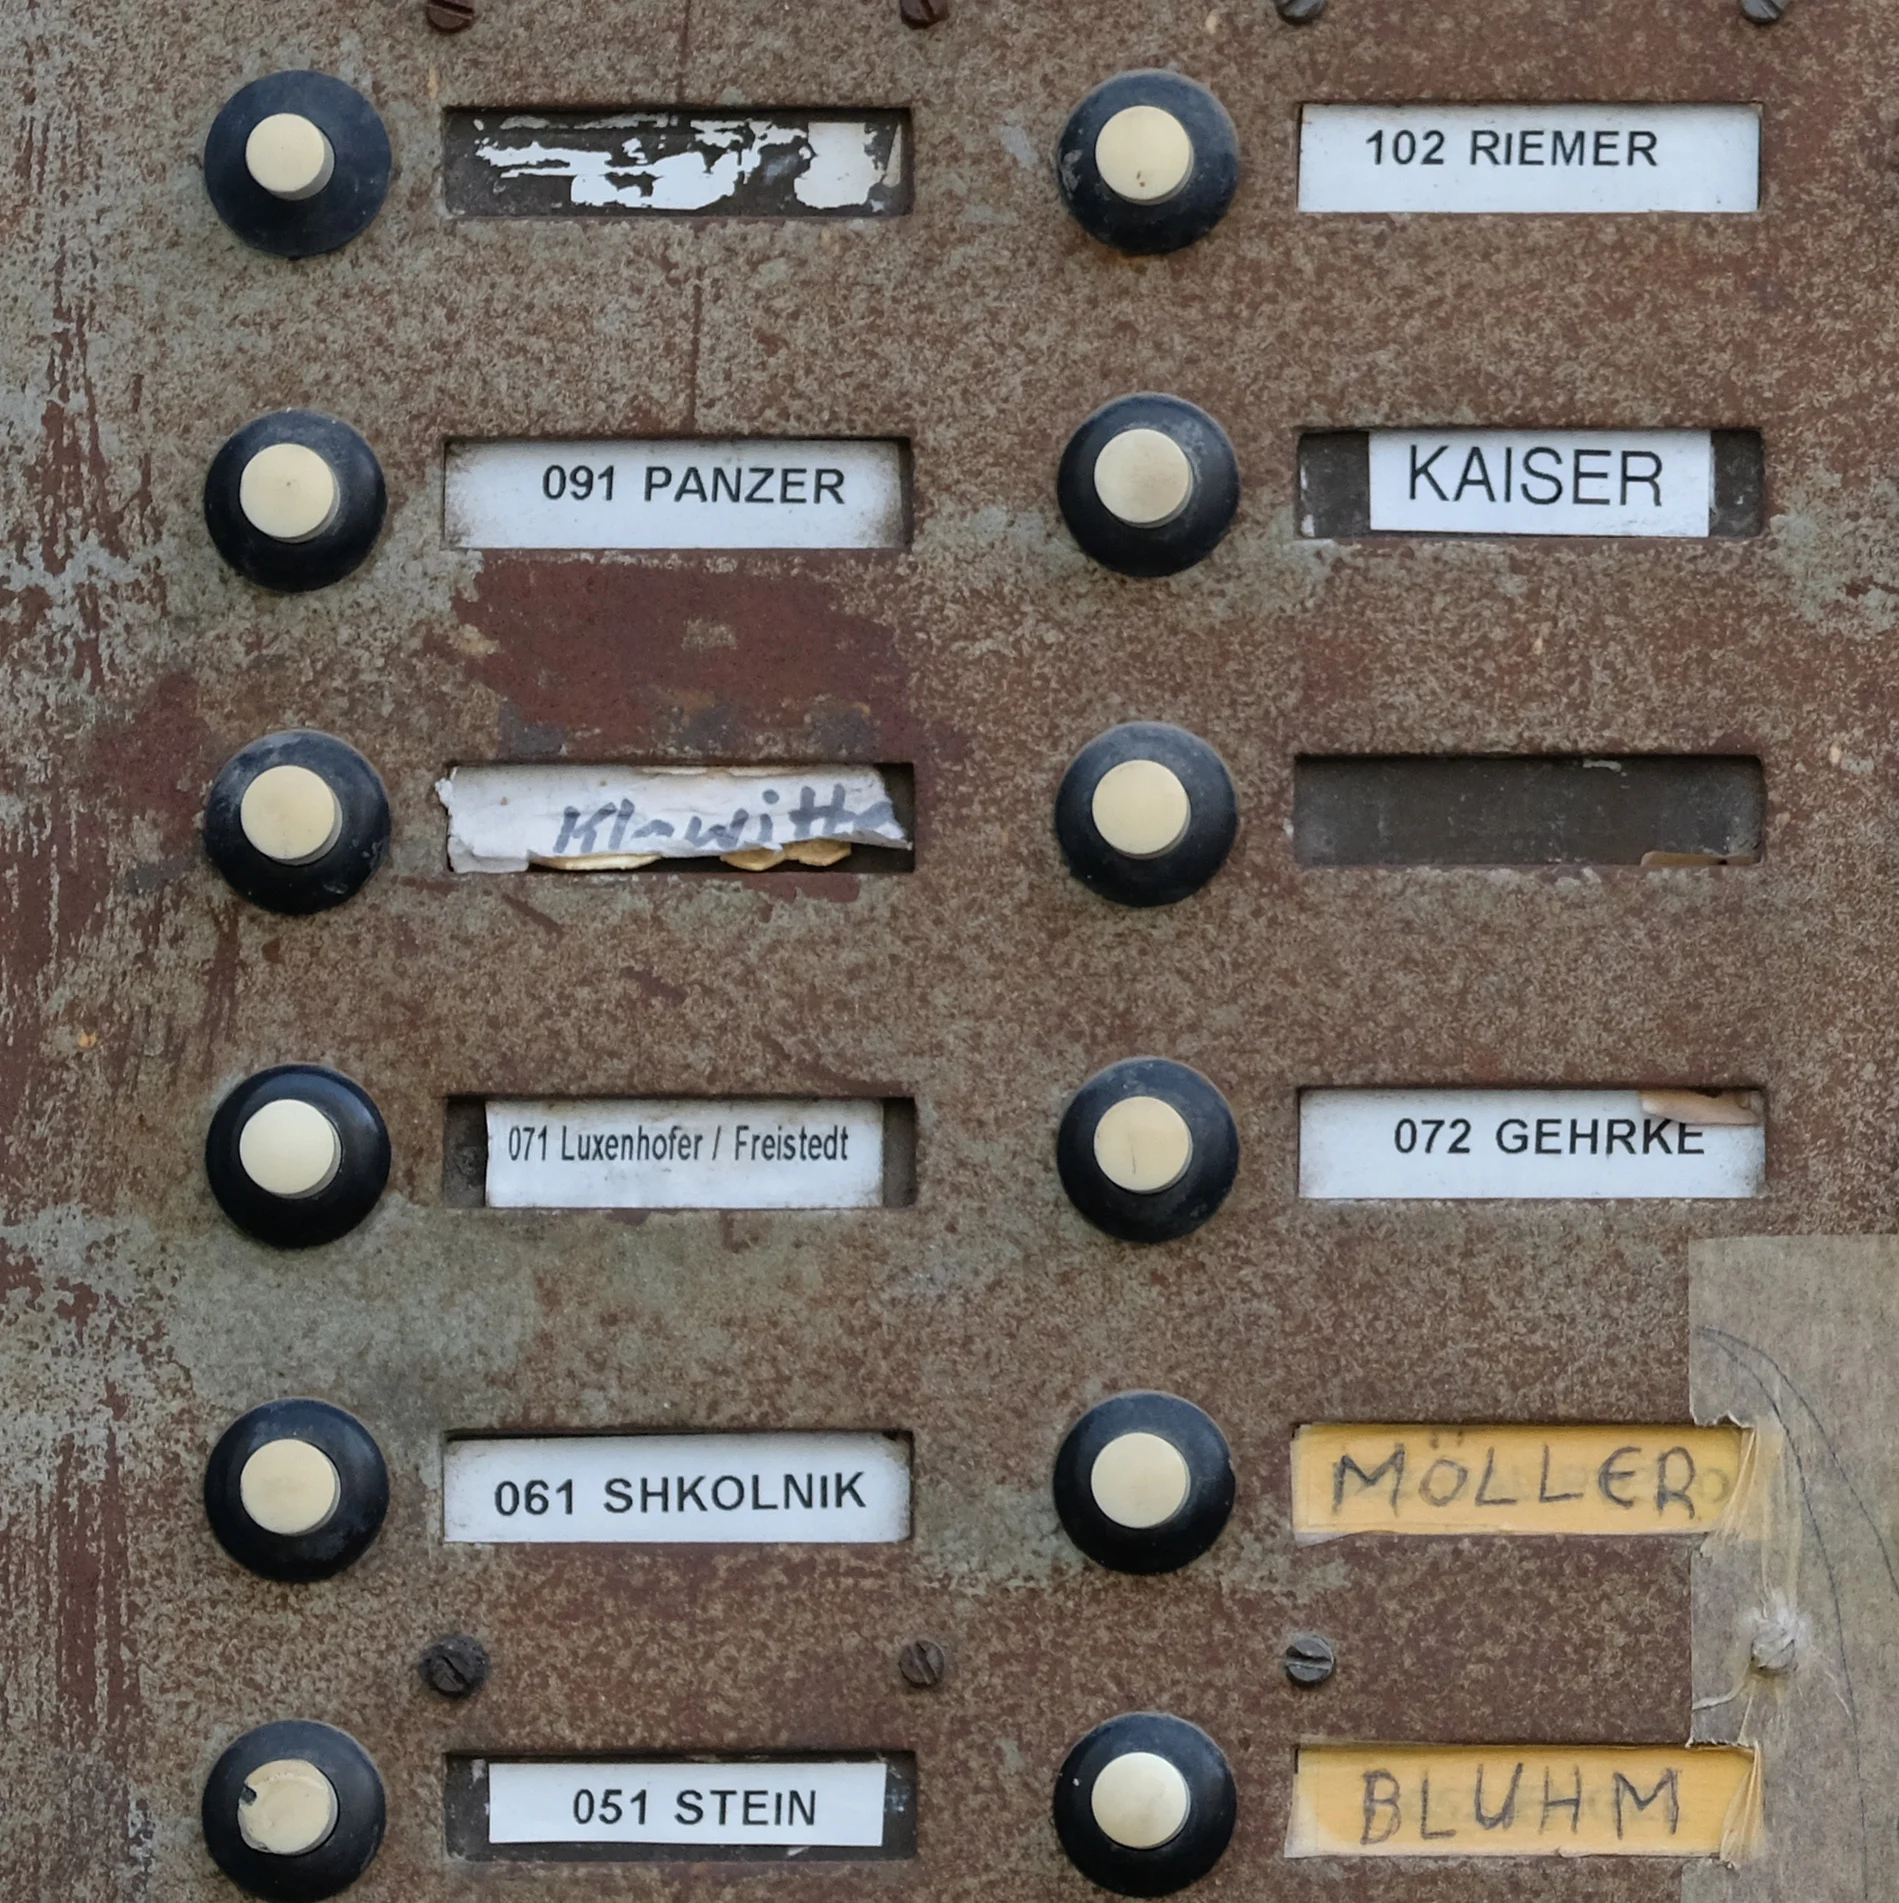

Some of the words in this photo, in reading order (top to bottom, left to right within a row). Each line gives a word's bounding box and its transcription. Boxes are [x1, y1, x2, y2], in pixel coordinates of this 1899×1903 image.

[1366, 129, 1445, 165] 102
[1470, 129, 1658, 167] RIEMER
[542, 464, 615, 501] 091
[644, 466, 845, 505] PANZER
[1409, 443, 1663, 507] KAISER
[508, 1124, 548, 1161] 071
[561, 1124, 704, 1161] Luxenhofer
[734, 1124, 849, 1161] Freistedt
[1394, 1117, 1472, 1154] 072
[1495, 1113, 1713, 1155] GEHRKE
[494, 1478, 573, 1517] 061
[603, 1471, 866, 1514] SHKOLNIK
[1333, 1431, 1697, 1520] MÖLLER
[573, 1788, 647, 1825] 051
[674, 1789, 816, 1826] STEIN
[1360, 1761, 1681, 1846] BLUHM
